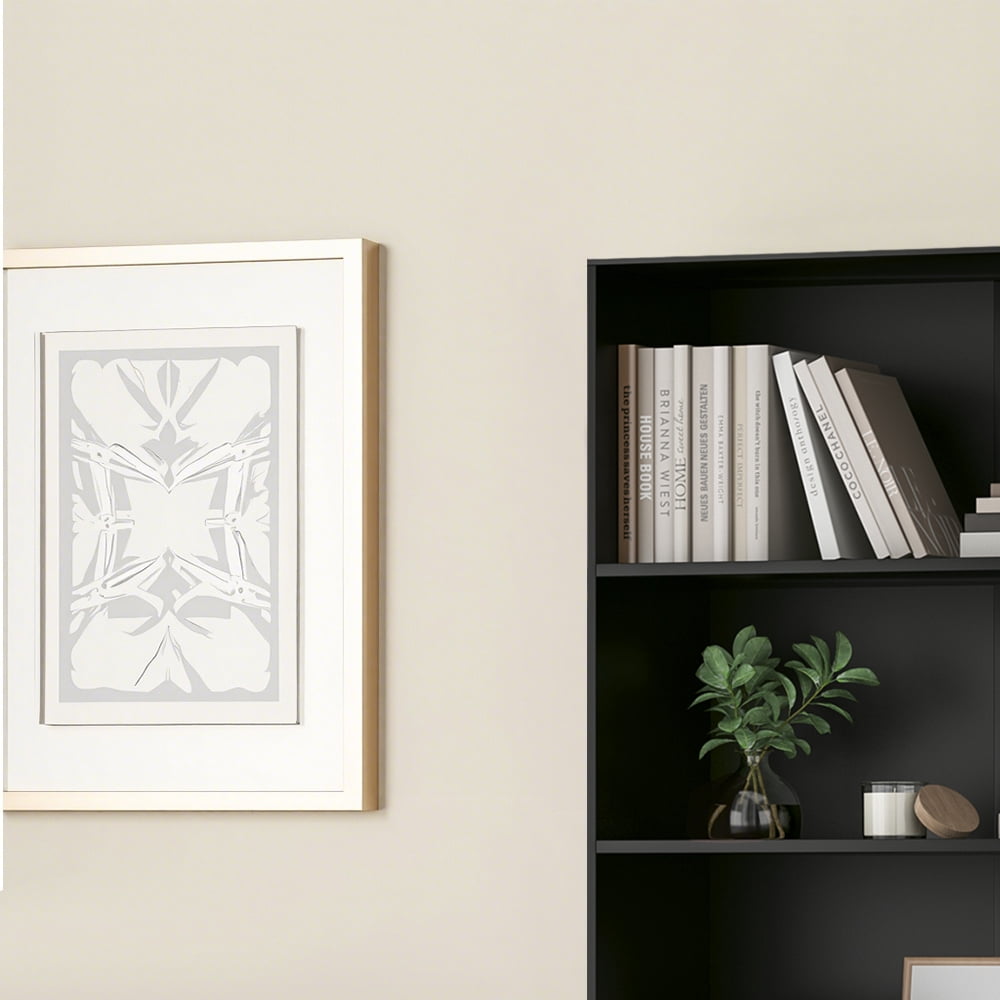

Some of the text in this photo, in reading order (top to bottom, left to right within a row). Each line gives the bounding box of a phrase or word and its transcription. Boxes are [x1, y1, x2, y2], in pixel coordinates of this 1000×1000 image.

[621, 385, 633, 540] the princess saves herself
[639, 415, 652, 501] HOUSE BOOK
[659, 389, 670, 517] BRIANNA WIEST
[675, 457, 686, 511] HOME
[700, 384, 709, 522] NEUES BAUEN NEUES GESTALTEN
[803, 457, 819, 497] design
